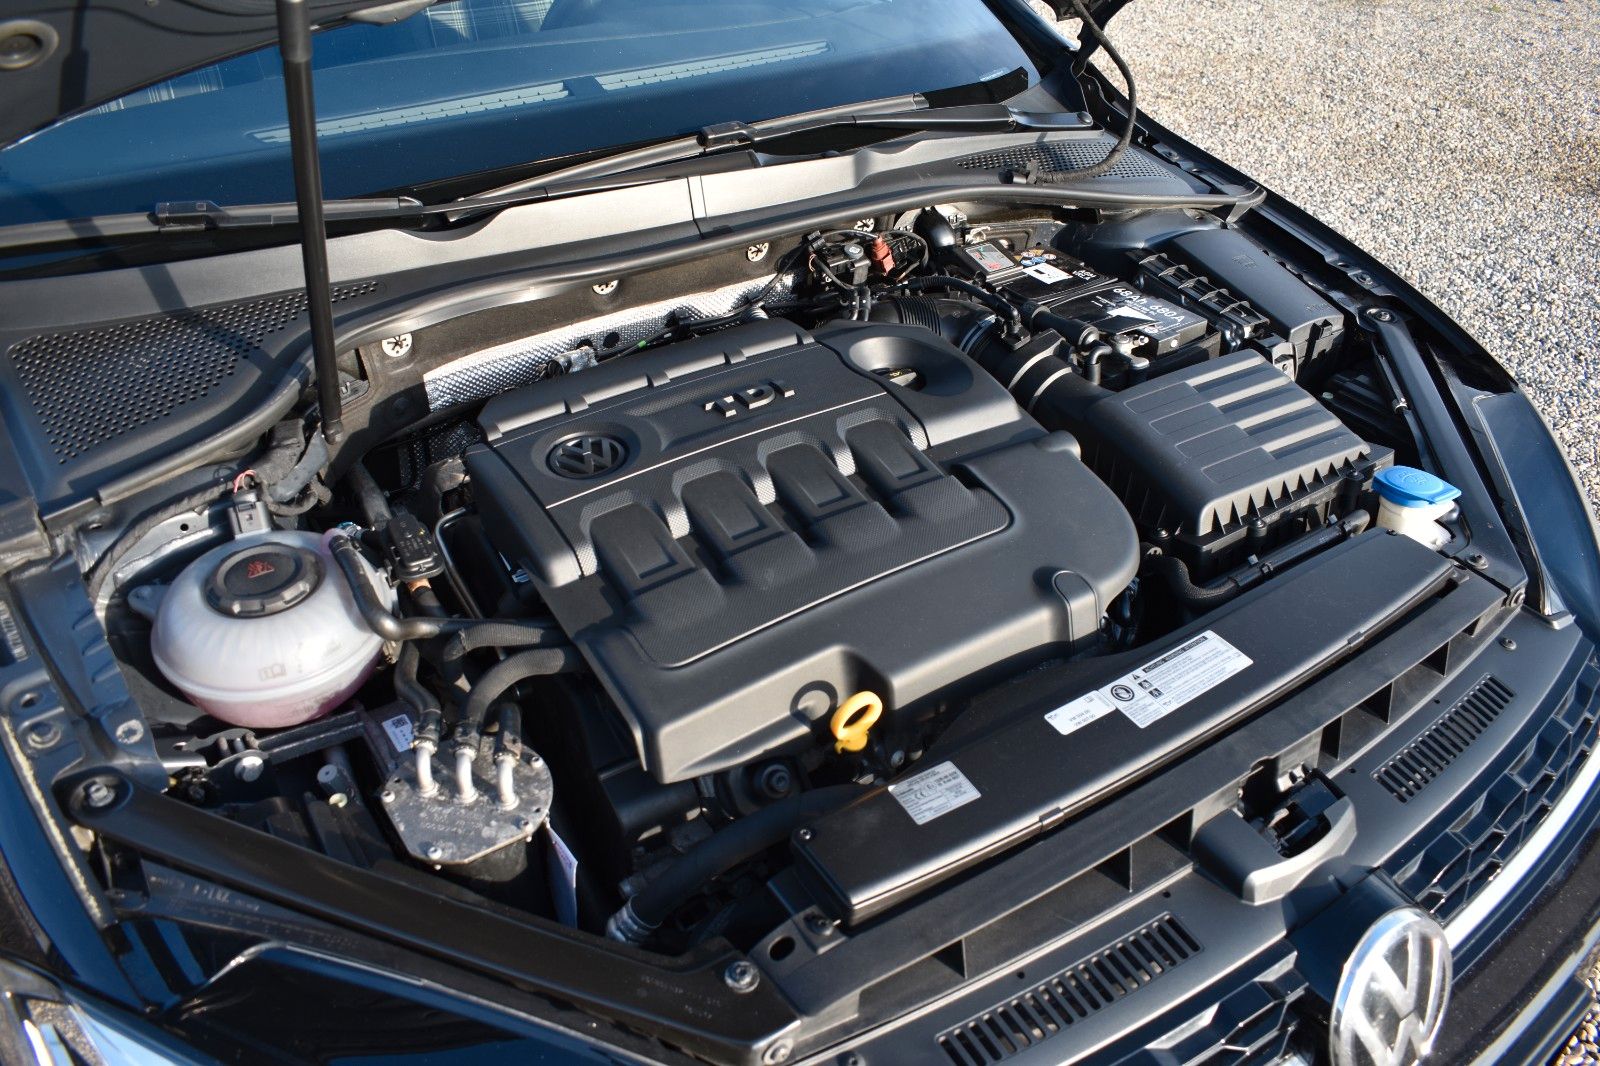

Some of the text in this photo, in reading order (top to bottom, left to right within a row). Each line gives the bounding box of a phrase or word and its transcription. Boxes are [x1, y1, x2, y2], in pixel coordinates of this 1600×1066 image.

[1113, 288, 1147, 305] 68Ah
[1150, 305, 1185, 322] 680A
[703, 380, 795, 418] TDI
[547, 432, 626, 479] VW
